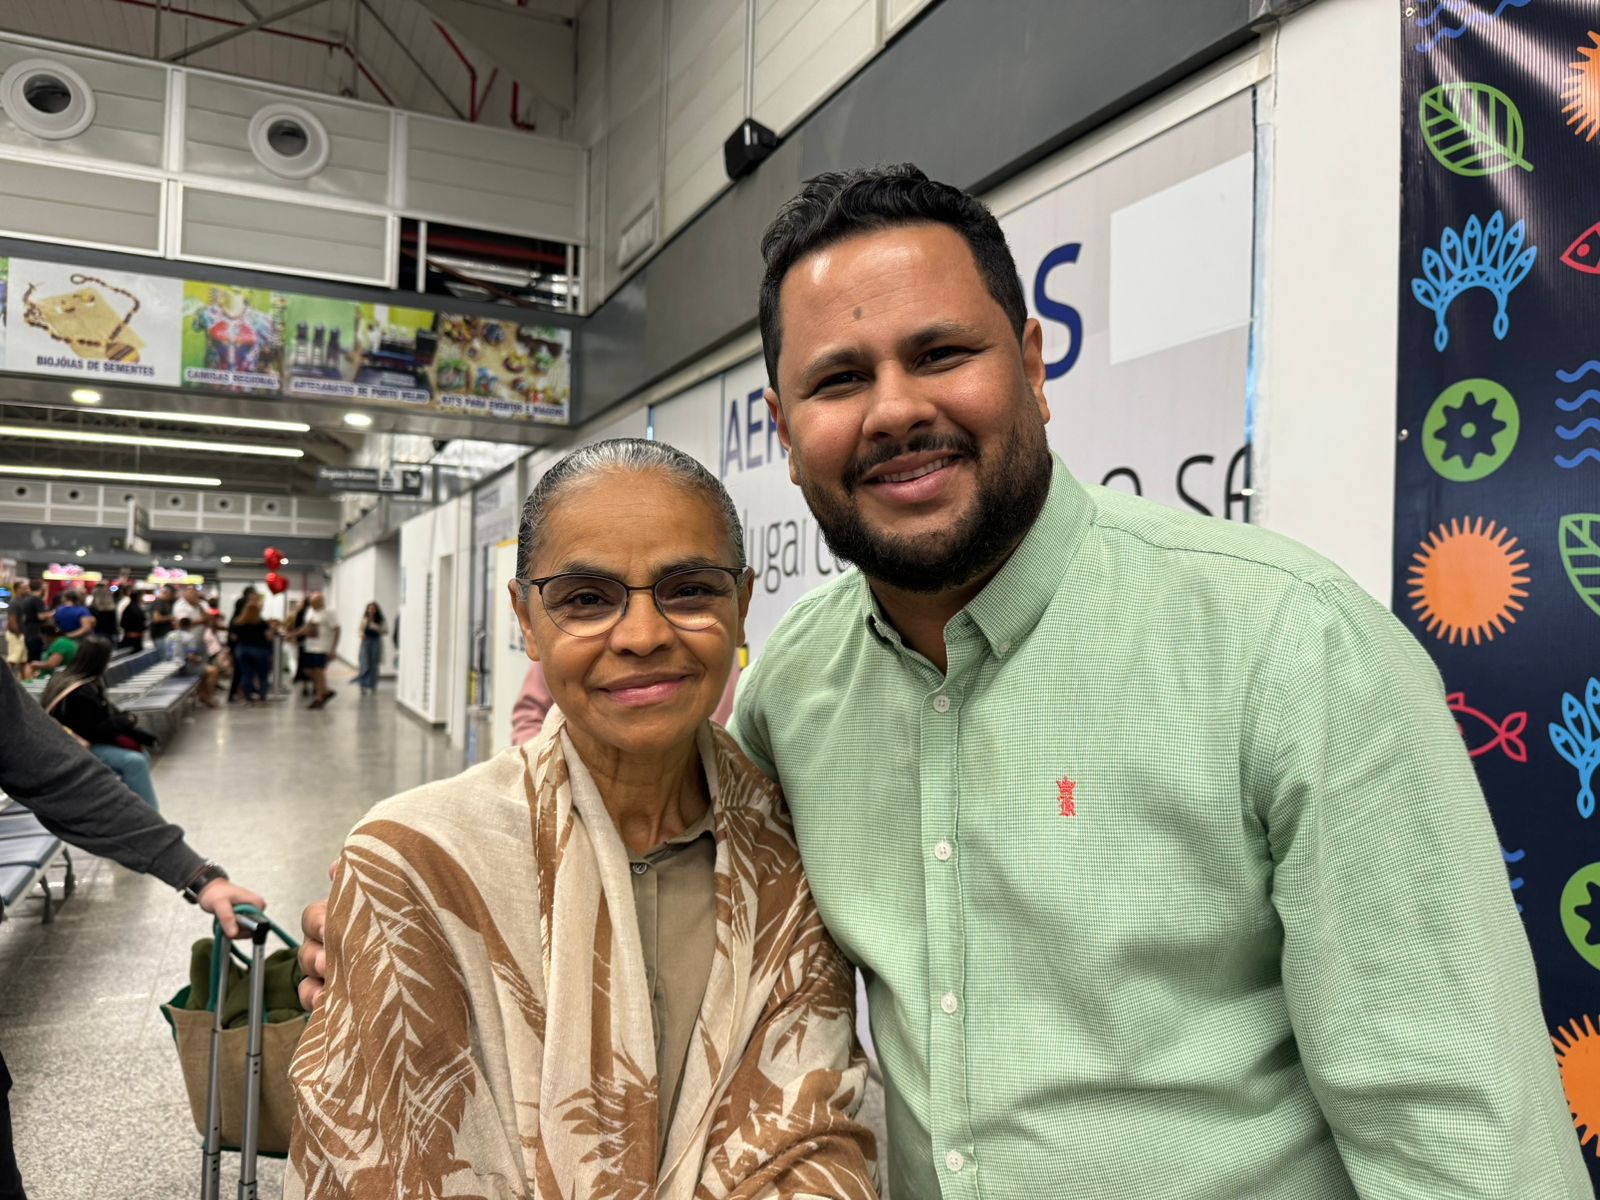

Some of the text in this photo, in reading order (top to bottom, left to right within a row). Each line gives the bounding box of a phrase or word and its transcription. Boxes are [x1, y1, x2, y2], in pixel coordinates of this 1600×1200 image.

[1033, 242, 1083, 381] S
[87, 361, 99, 371] DE
[103, 362, 155, 376] SEMENTES
[723, 387, 790, 477] AER
